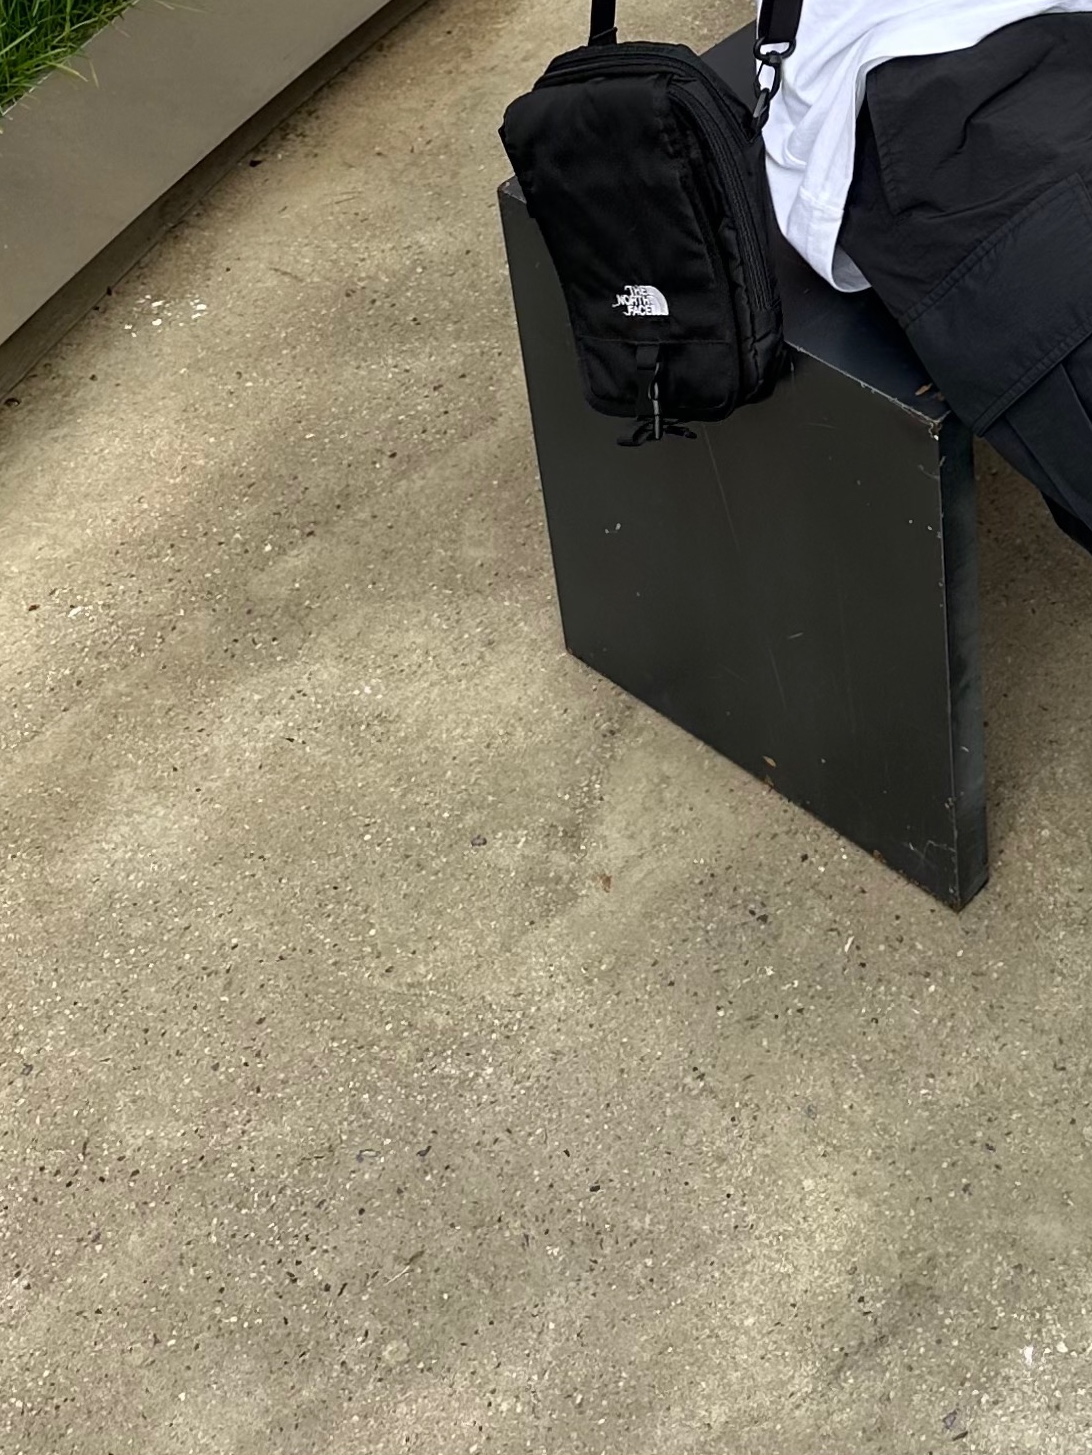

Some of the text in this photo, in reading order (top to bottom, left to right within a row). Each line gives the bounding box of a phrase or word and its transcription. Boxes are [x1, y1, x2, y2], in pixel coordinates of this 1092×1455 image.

[624, 285, 649, 296] THE
[612, 294, 650, 307] NORTH
[622, 305, 653, 316] FACE
